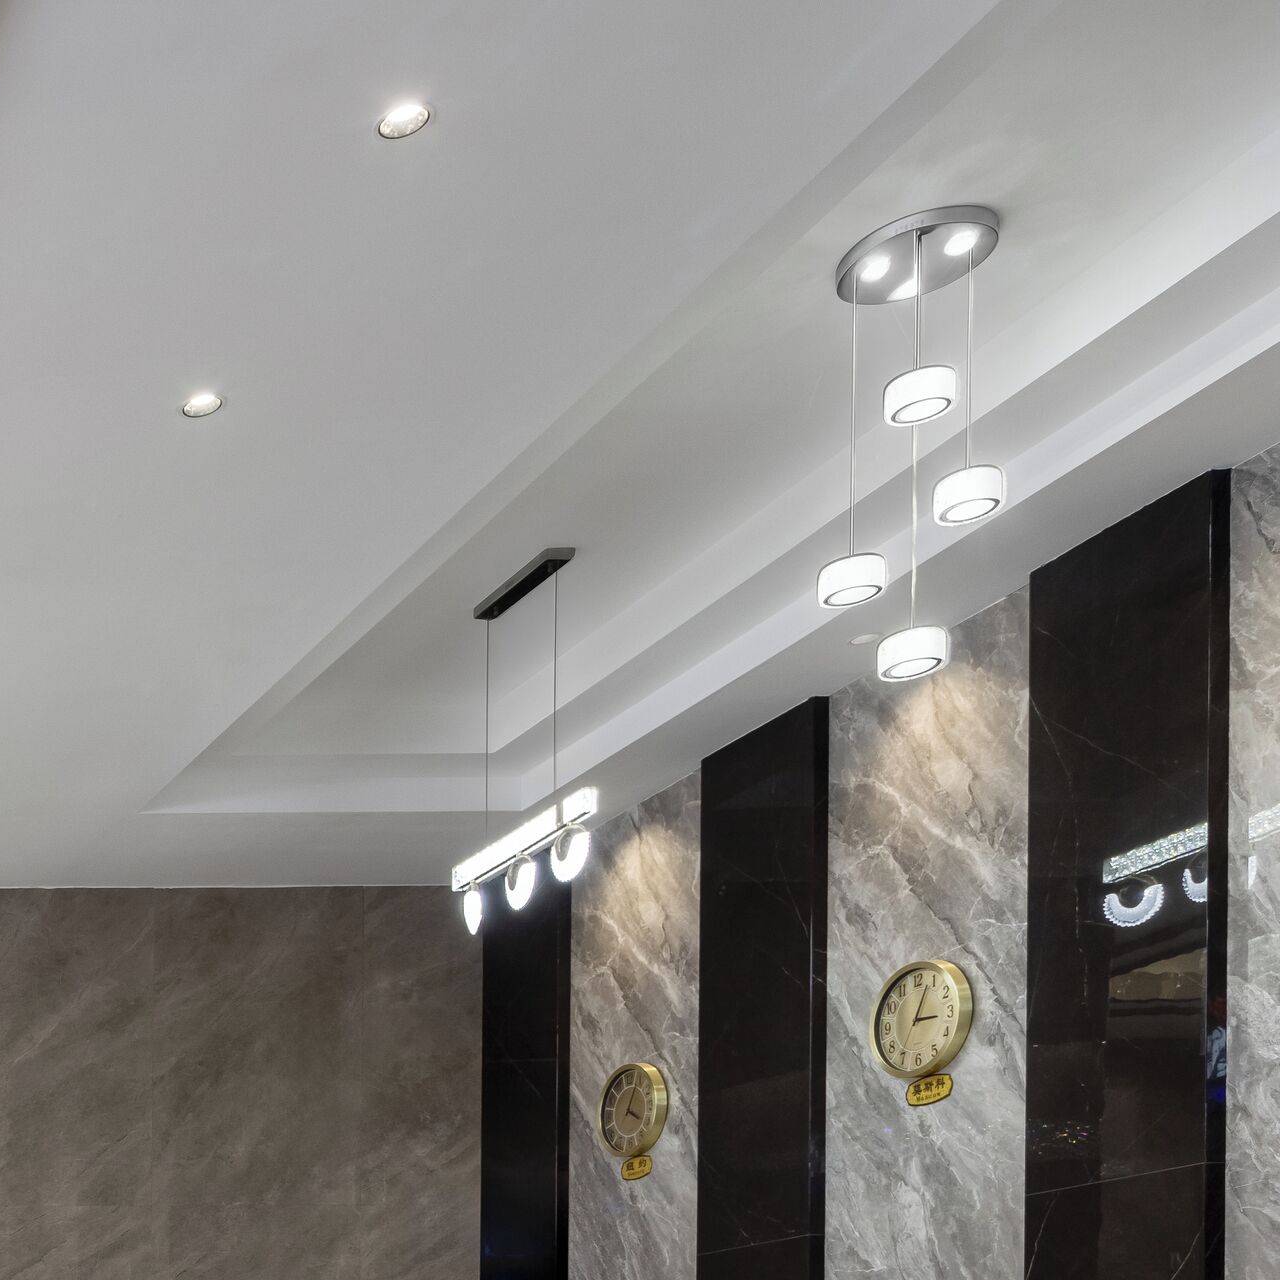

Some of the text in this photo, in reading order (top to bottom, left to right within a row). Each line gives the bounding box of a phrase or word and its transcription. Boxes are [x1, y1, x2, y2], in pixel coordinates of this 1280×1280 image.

[913, 973, 923, 988] 12
[932, 974, 936, 988] 1
[898, 983, 907, 997] 11
[942, 985, 950, 999] 2
[886, 1000, 897, 1015] 10
[947, 1004, 954, 1018] 3
[884, 1022, 891, 1035] 9
[943, 1026, 949, 1037] 4
[888, 1040, 896, 1054] 8
[931, 1044, 938, 1058] 5
[900, 1051, 906, 1065] 7
[915, 1053, 922, 1067] 6
[913, 1078, 945, 1096] 莫斯科
